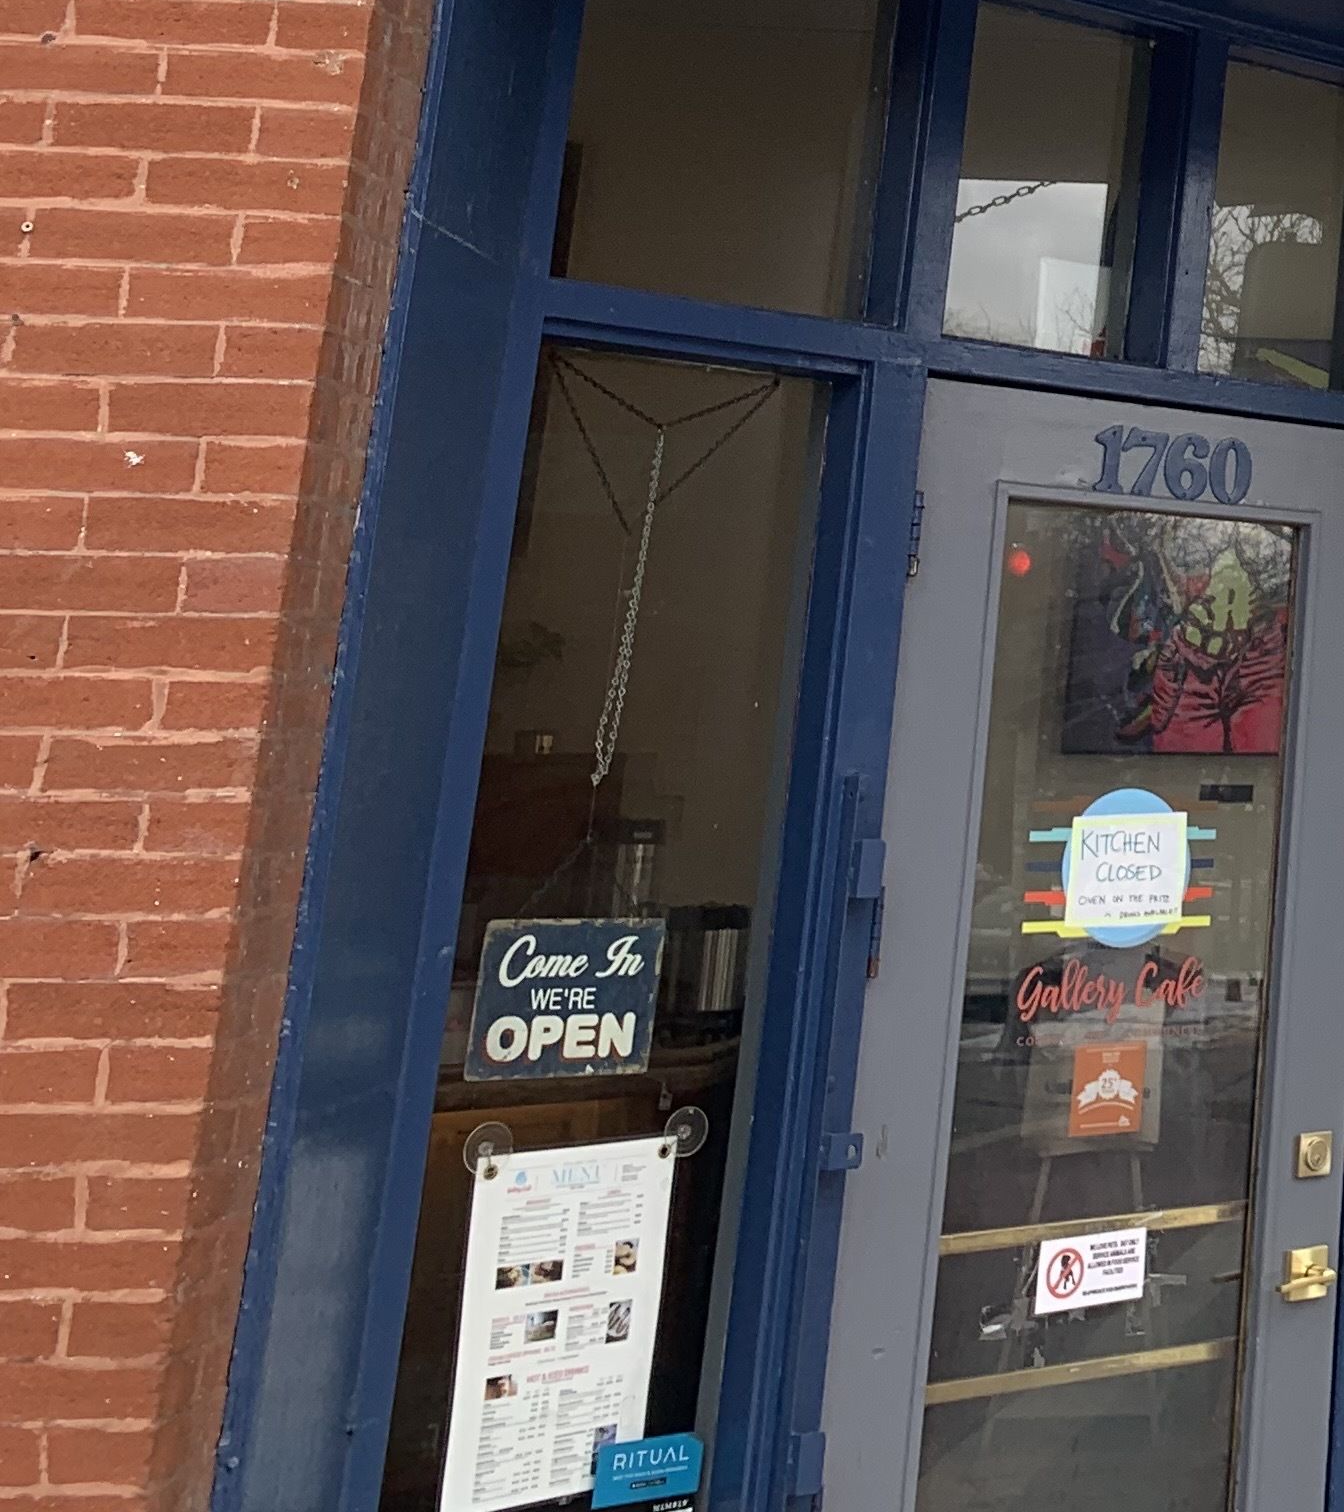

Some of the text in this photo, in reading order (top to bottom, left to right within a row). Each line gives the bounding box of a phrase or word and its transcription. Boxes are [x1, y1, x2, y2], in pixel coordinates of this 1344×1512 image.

[1093, 423, 1253, 504] 1760
[1081, 829, 1161, 860] KITCHEN
[1096, 862, 1162, 882] CLOSED
[1078, 895, 1106, 906] OVEN
[499, 934, 645, 988] Come In
[530, 988, 597, 1012] WE'RE
[1016, 959, 1126, 1025] Gallery
[486, 1011, 637, 1062] OPEN
[613, 1444, 690, 1471] RITUAL
